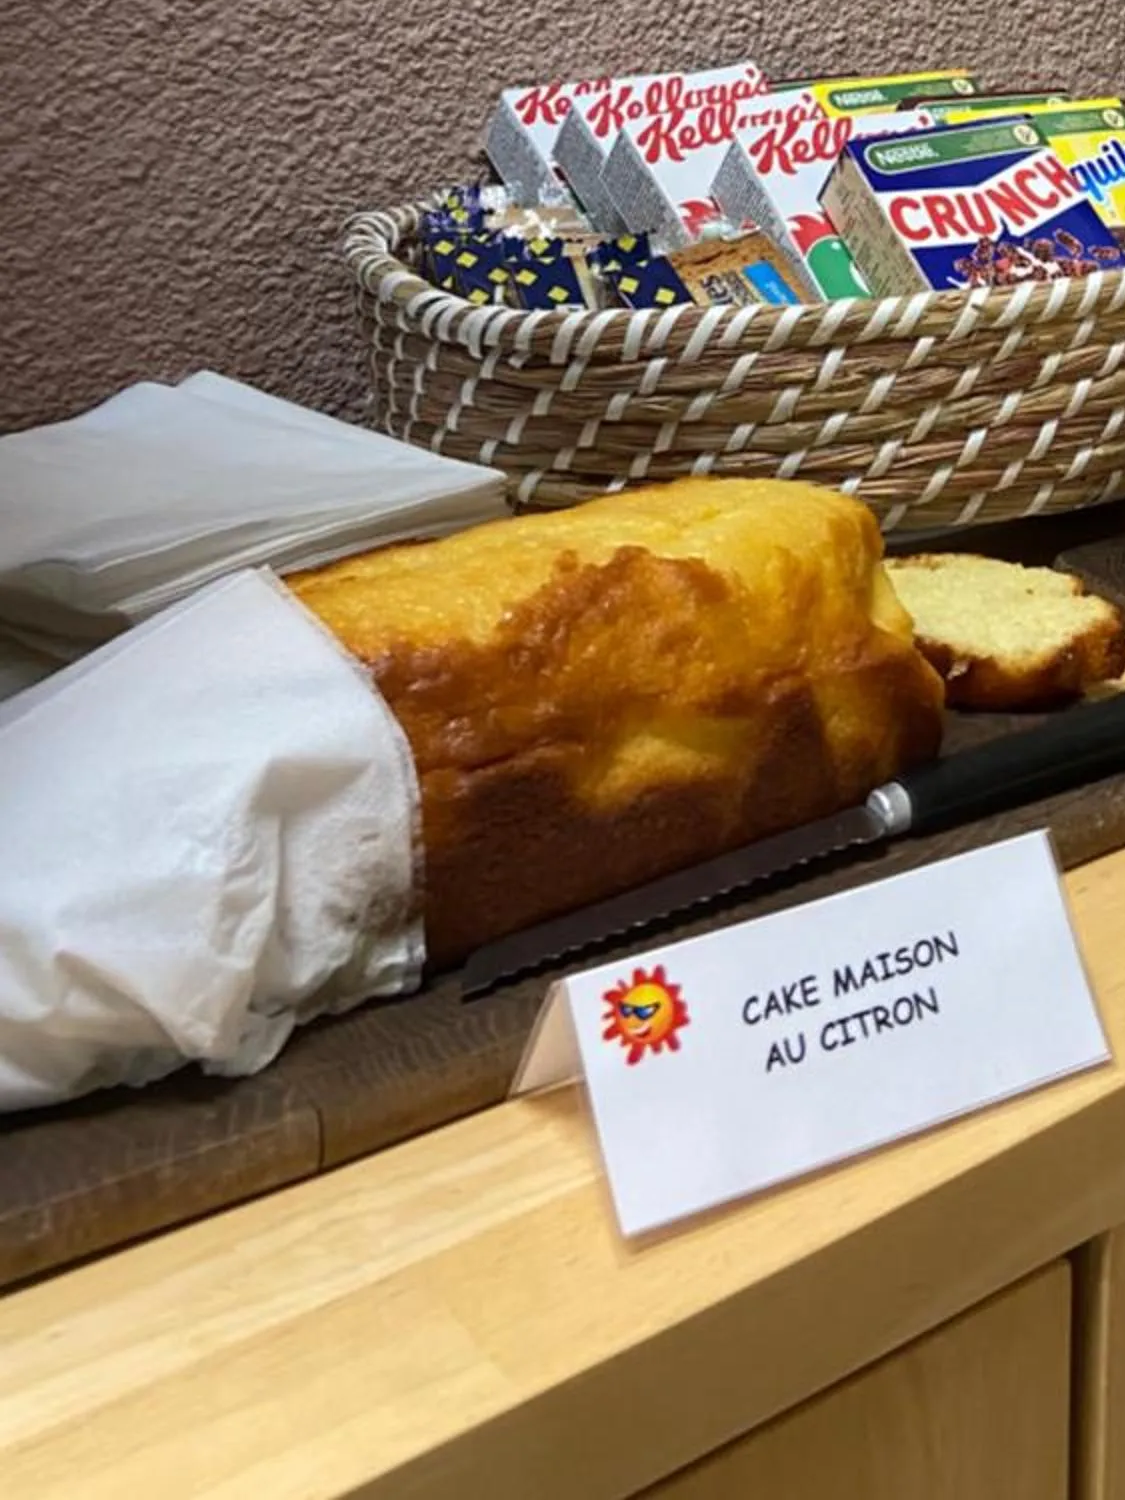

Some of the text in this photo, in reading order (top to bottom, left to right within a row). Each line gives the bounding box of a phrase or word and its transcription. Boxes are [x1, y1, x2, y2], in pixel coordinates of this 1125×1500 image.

[888, 155, 1084, 241] CRUNCH
[742, 931, 960, 1025] CAKE MAISON
[765, 986, 940, 1073] AU CITRON
